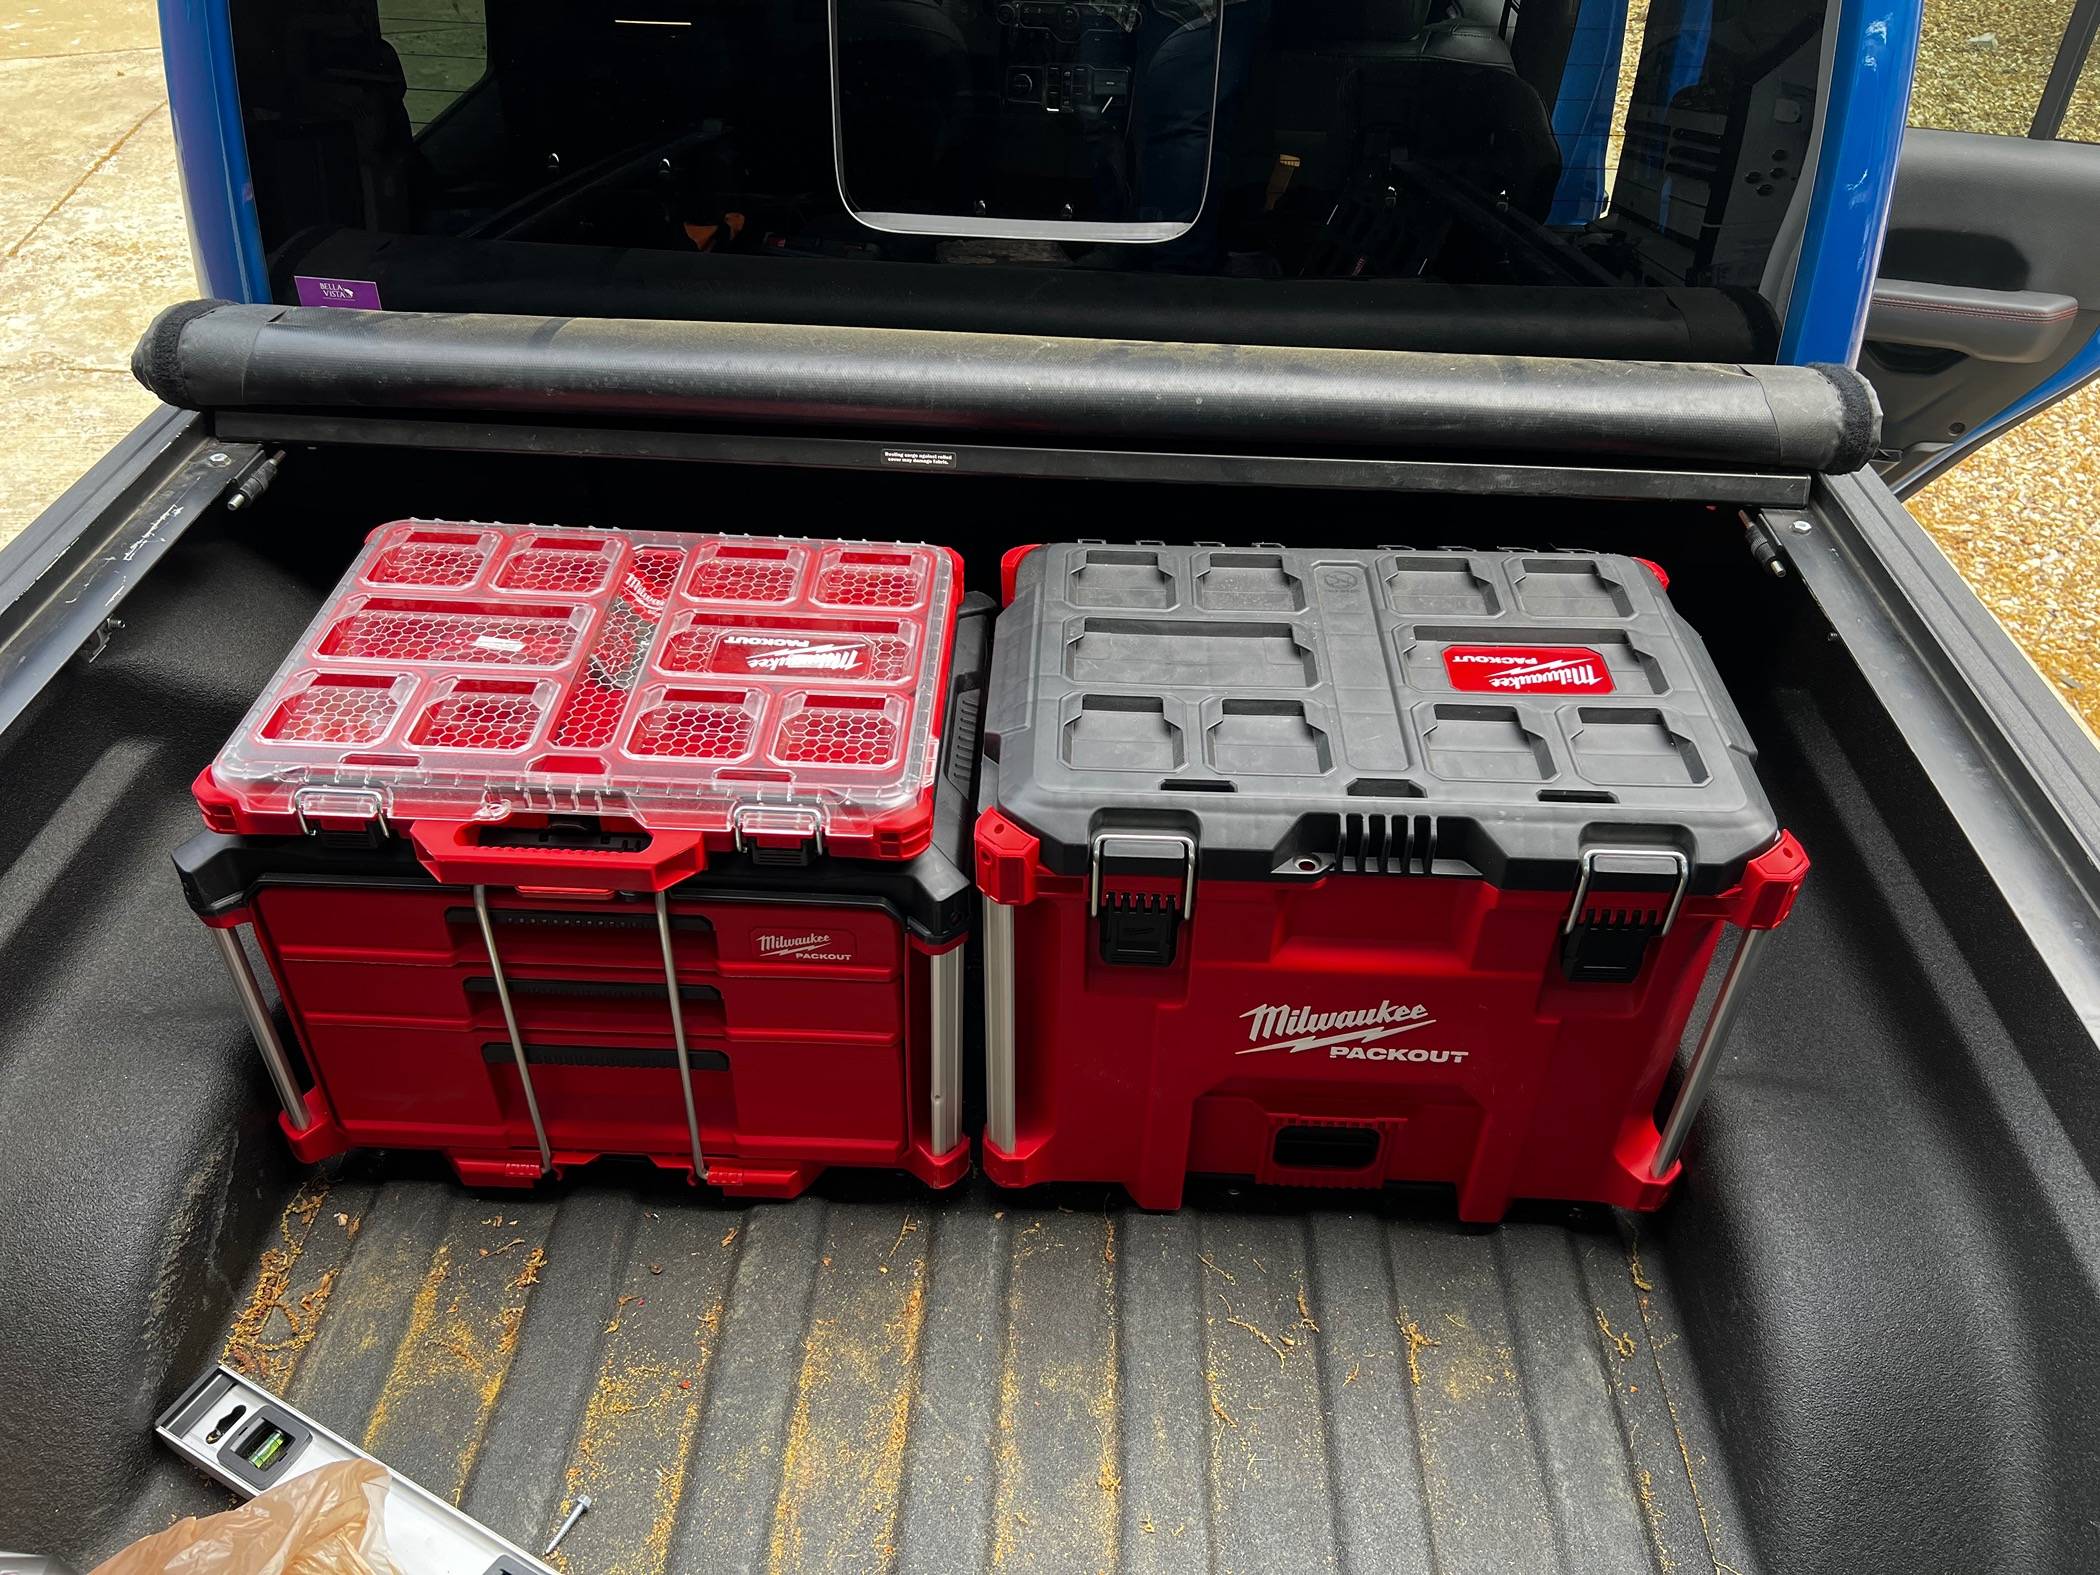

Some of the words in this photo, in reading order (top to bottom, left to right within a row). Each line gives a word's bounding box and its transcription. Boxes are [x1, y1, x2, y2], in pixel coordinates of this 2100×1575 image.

[320, 282, 344, 291] BELLA
[323, 289, 346, 298] VISTA
[724, 636, 810, 648] PACKOUT
[1452, 655, 1539, 665] PACKOUT
[1488, 664, 1604, 690] Milwaukee
[755, 932, 832, 952] Milwaukee
[795, 952, 852, 961] PACKOUT
[1239, 1000, 1429, 1042] Milwaukee
[1329, 1046, 1469, 1064] PACKOUT
